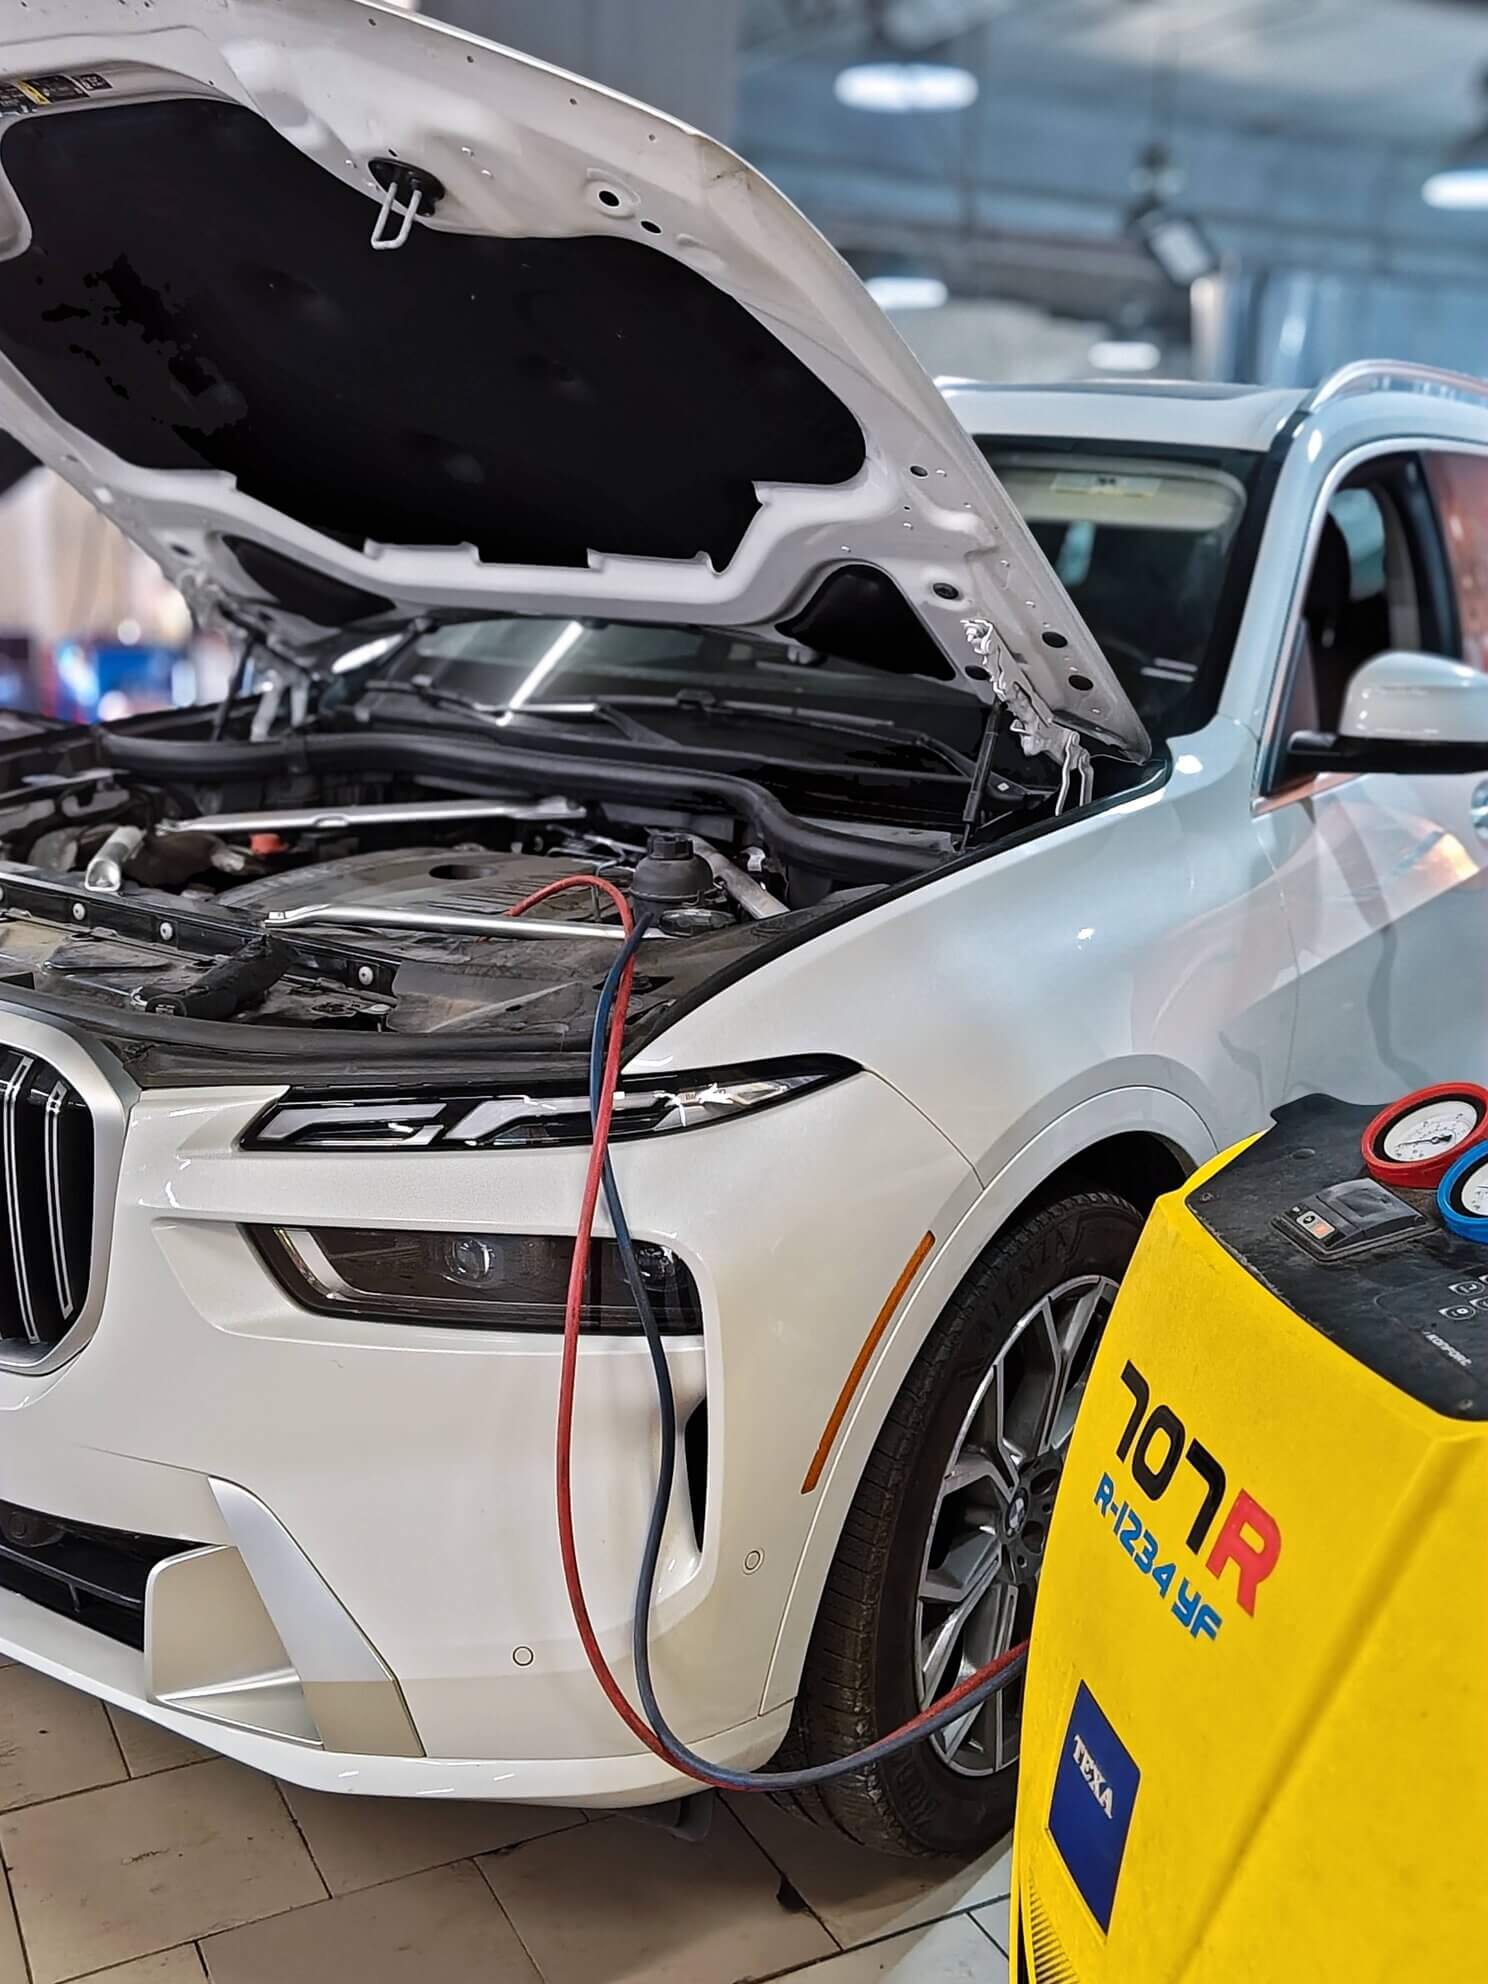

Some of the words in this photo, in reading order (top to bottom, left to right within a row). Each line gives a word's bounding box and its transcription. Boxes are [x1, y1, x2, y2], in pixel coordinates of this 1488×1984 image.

[1093, 1471, 1177, 1600] R-1234
[1116, 1359, 1282, 1618] 707R
[1072, 1733, 1113, 1820] TEXA
